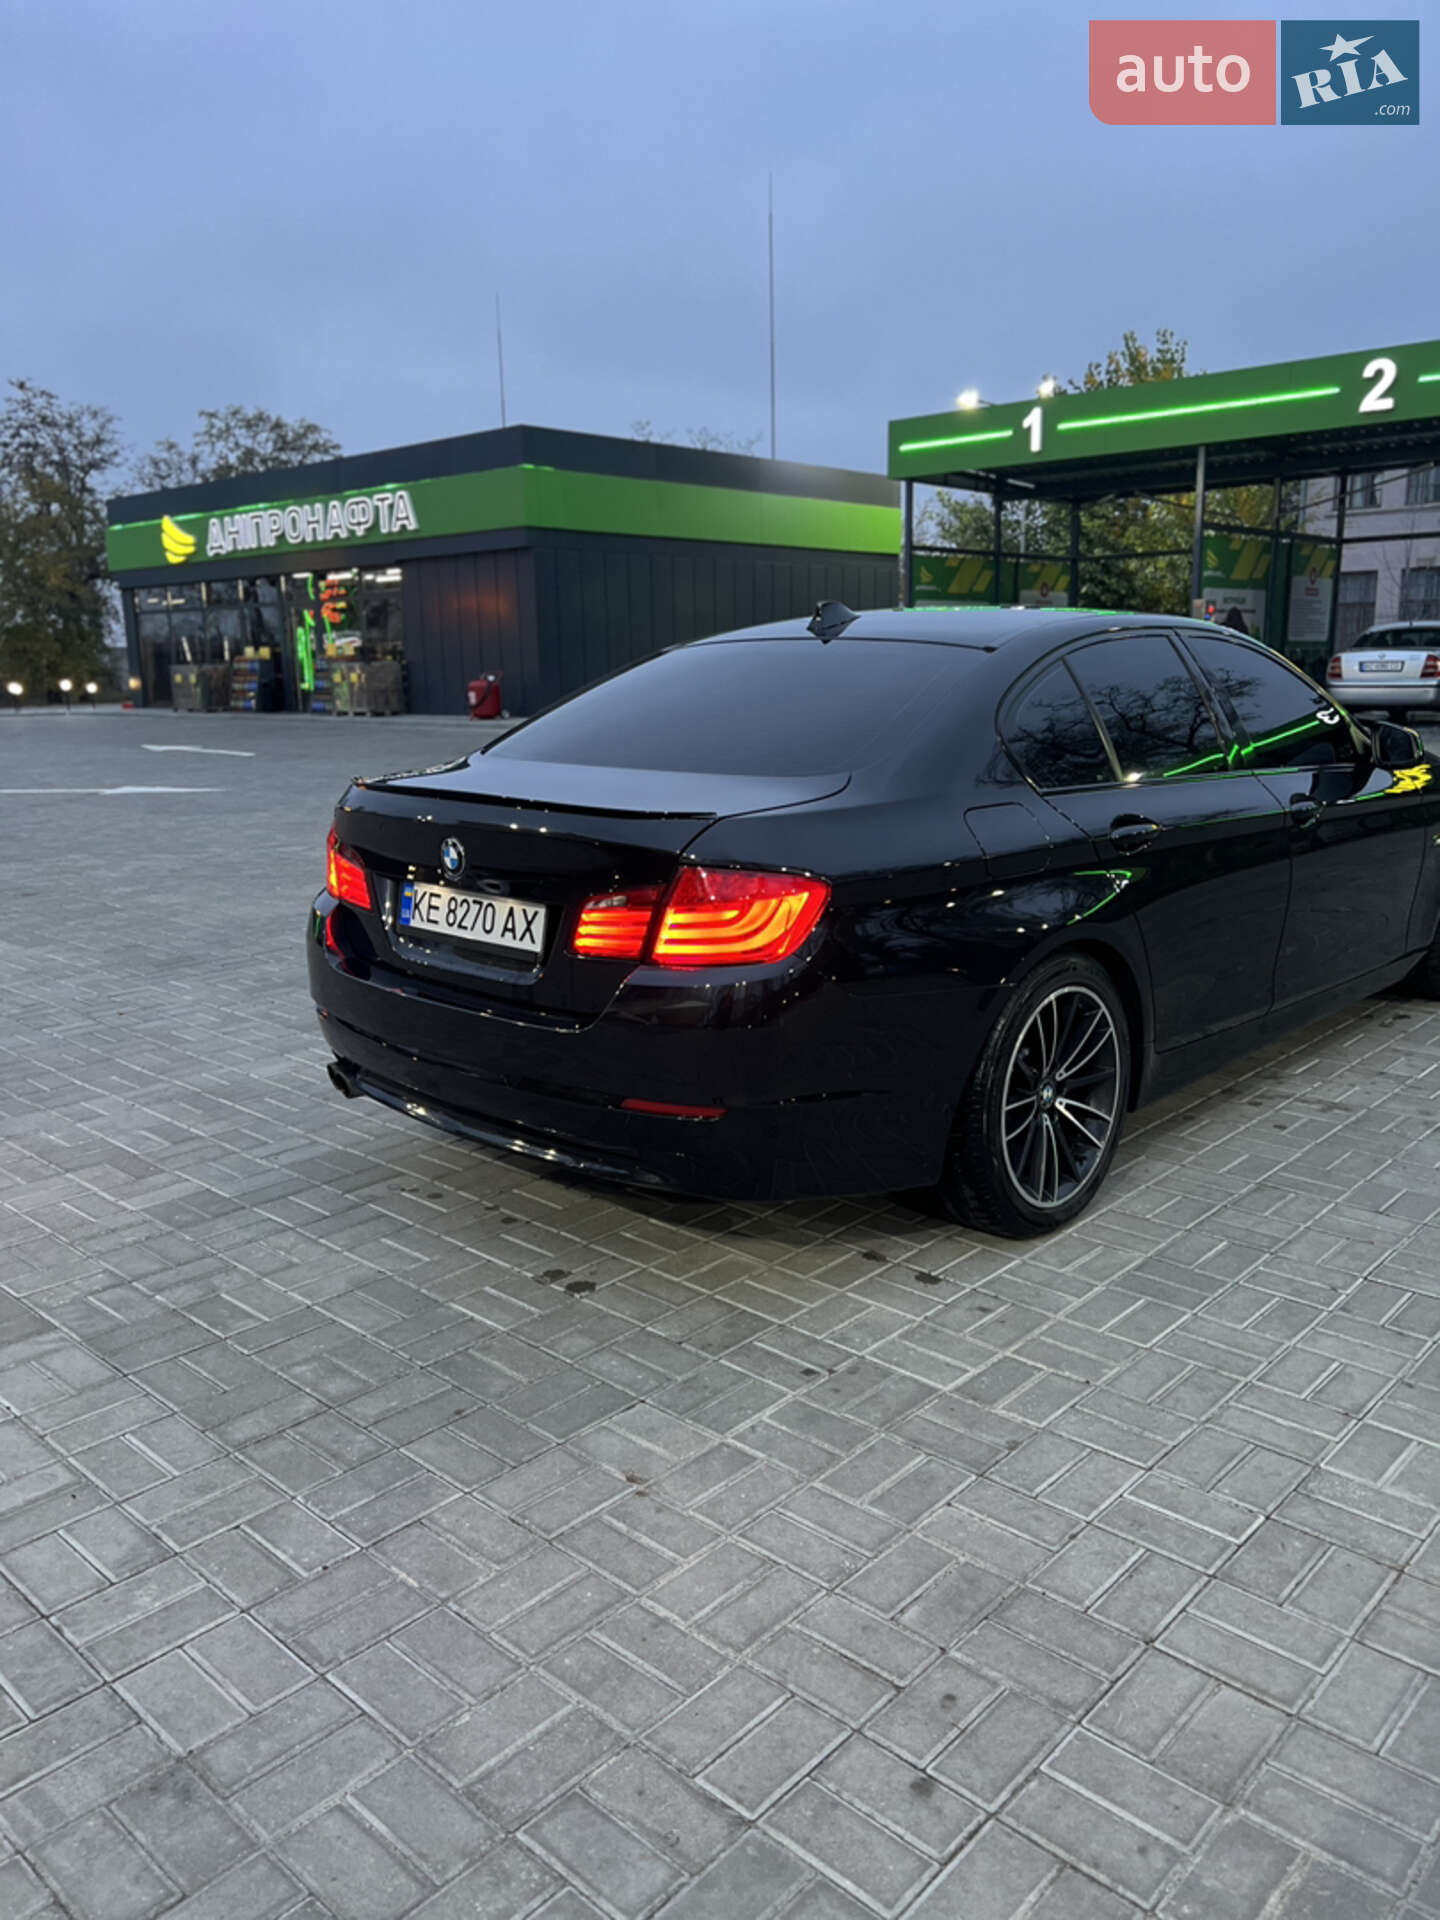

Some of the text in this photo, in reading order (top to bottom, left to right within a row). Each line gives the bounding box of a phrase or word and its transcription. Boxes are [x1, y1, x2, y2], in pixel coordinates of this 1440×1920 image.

[1357, 357, 1399, 413] 2
[1021, 405, 1044, 453] 1
[206, 490, 419, 557] ДНІПРОНАФТА
[412, 889, 540, 945] KE 8270 AX
